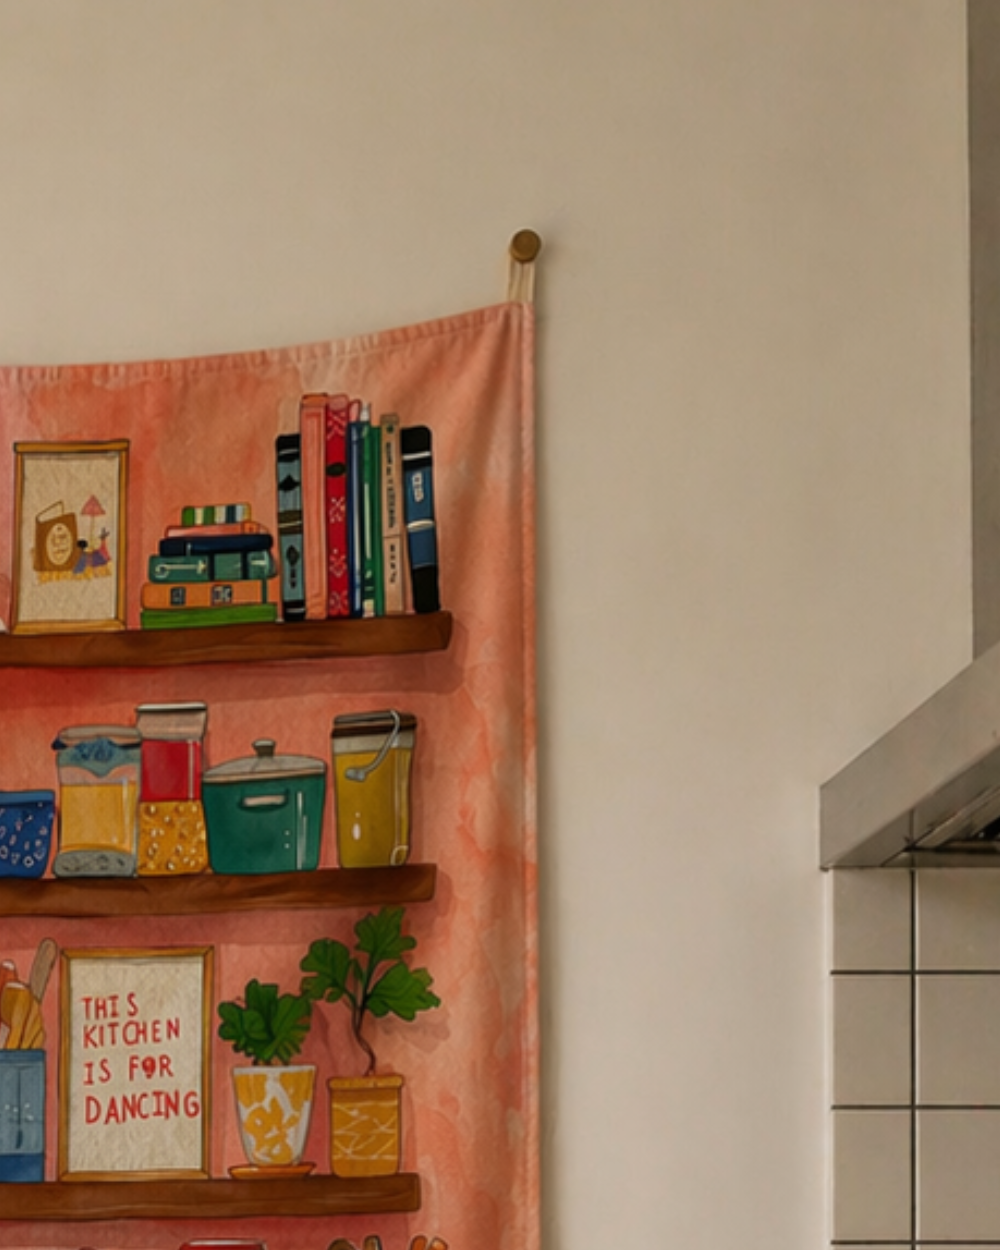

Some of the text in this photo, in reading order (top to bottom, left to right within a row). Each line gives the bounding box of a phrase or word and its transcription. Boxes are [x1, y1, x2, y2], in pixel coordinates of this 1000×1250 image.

[81, 992, 139, 1020] THIS
[82, 1017, 181, 1049] KITCHEN
[83, 1054, 174, 1086] IS FOR
[84, 1089, 200, 1125] DANCING
